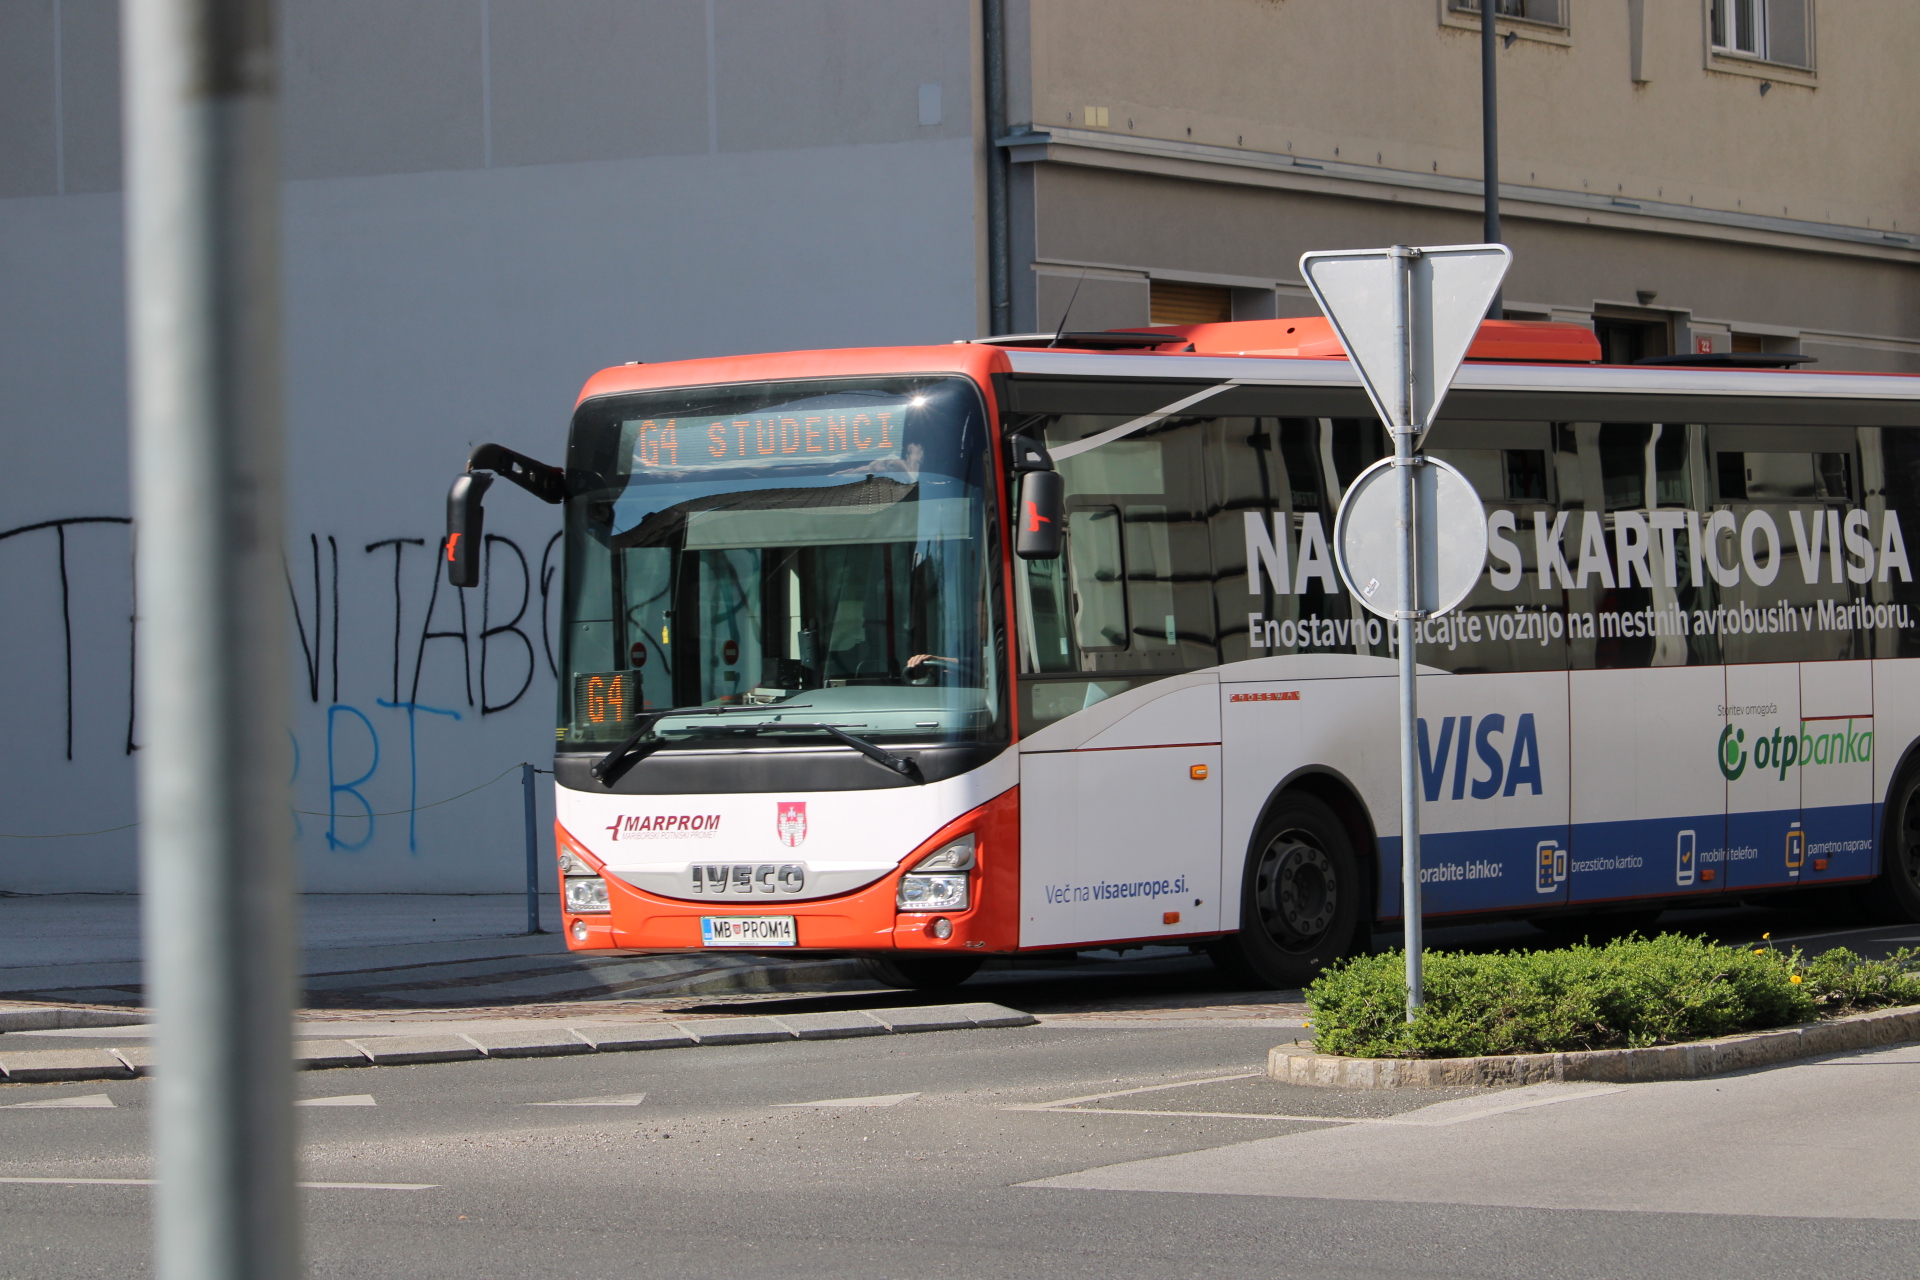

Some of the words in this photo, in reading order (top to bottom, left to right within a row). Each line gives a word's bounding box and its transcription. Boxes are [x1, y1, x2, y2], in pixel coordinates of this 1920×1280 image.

[1701, 340, 1710, 352] 22
[640, 419, 678, 467] G4
[708, 412, 892, 458] STUDENCI
[1243, 511, 1339, 595] NA
[1533, 509, 1781, 590] KARTICO
[1789, 508, 1913, 585] VISA
[1248, 612, 1382, 648] Enostavno
[1485, 605, 1564, 647] vožnjo
[1567, 611, 1595, 639] na
[1599, 601, 1690, 638] mestnih
[1693, 599, 1798, 636] avtobusih
[1800, 606, 1813, 632] v
[1816, 597, 1915, 631] Mariboru.
[588, 675, 623, 723] G4
[1230, 691, 1300, 702] CROSSWAY
[1717, 704, 1745, 717] Storitev
[1745, 703, 1778, 716] omogoča
[1417, 712, 1543, 802] VISA
[624, 814, 721, 831] MARPROM
[1701, 848, 1730, 863] mobilni
[1730, 846, 1758, 860] telefon
[1808, 841, 1842, 857] pametno
[1465, 859, 1502, 879] lahko:
[1571, 856, 1614, 872] brezstično
[1615, 855, 1643, 869] kartico
[692, 864, 804, 893] IVECO
[1045, 884, 1071, 904] Več
[1073, 886, 1090, 902] na
[1092, 874, 1190, 900] visaeurope.si.
[713, 921, 732, 938] MB
[742, 920, 791, 938] PROM14
